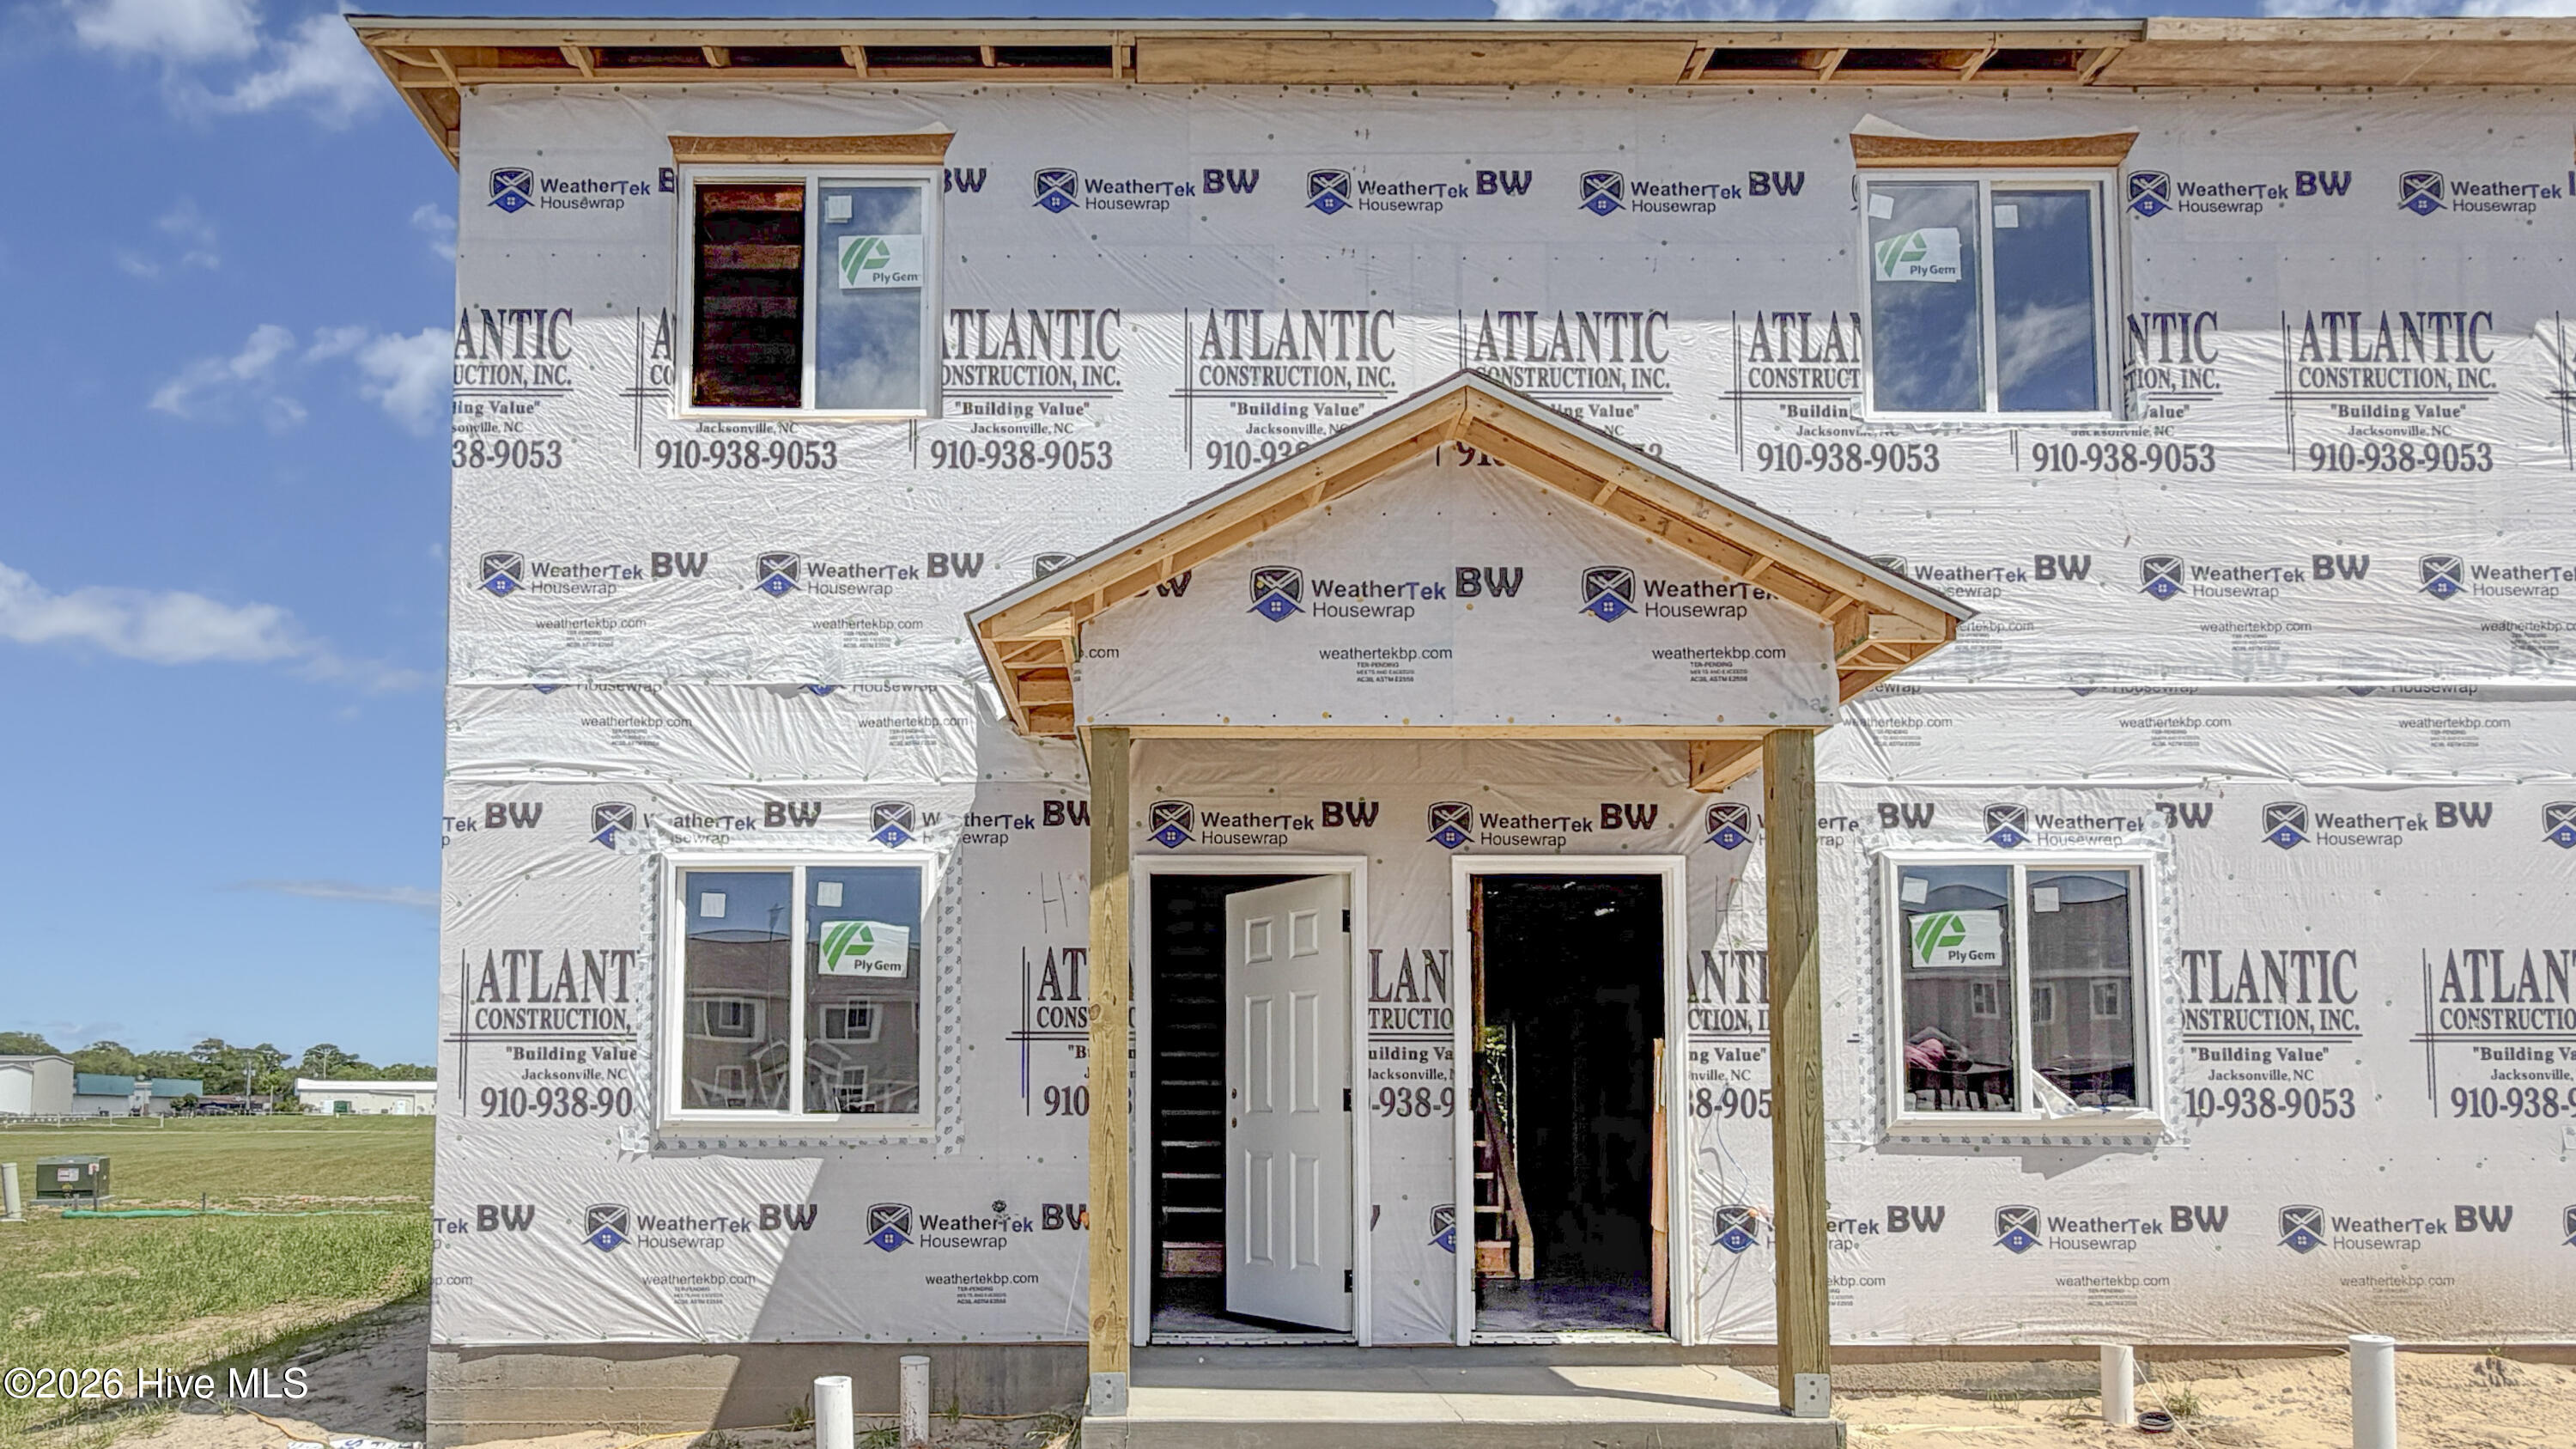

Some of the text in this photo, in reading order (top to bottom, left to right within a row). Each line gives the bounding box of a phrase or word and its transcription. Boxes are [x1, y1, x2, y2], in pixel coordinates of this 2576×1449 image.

[540, 178, 651, 198] WeatherTek
[1084, 169, 1259, 198] WeatherTek BW
[1358, 171, 1532, 199] WeatherTek BW
[1631, 172, 1804, 200] WeatherTek BW
[2178, 172, 2352, 200] WeatherTek BW
[2451, 181, 2562, 200] WeatherTek
[540, 196, 624, 212] Housewrap
[1084, 196, 1170, 212] Housewrap
[1358, 198, 1443, 215] Housewrap
[1631, 199, 1716, 216] Housewrap
[2178, 200, 2263, 216] Housewrap
[2453, 200, 2537, 216] Housewrap
[872, 271, 919, 283] Ply Gem
[1911, 265, 1956, 277] Ply Gem
[1200, 308, 1394, 361] ATLANTIC
[1473, 310, 1670, 363] ATLANTIC
[2299, 311, 2493, 362] ATLANTIC
[534, 365, 572, 386] INC.
[1082, 366, 1121, 387] INC.
[1199, 366, 1394, 390] CONSTRUCTION, INC.
[1632, 368, 1670, 388] INC.
[2181, 368, 2220, 388] INC.
[2299, 367, 2497, 391] CONSTRUCTION, INC.
[489, 400, 540, 415] Value"
[955, 401, 1090, 418] "Building Value"
[1230, 401, 1365, 418] "Building Value"
[1589, 404, 1639, 419] Value"
[2145, 404, 2190, 418] alue"
[2331, 405, 2466, 421] "Building Value"
[504, 422, 524, 433] NC
[970, 422, 1074, 435] Jacksonville, NC
[1245, 423, 1326, 437] Jacksonville,
[2348, 425, 2451, 437] Jacksonville, NC
[655, 439, 838, 470] 910-938-9053
[931, 439, 1114, 470] 910-938-9053
[1757, 441, 1940, 472] 910-938-9053
[2032, 441, 2216, 472] 910-938-9053
[2309, 443, 2493, 472] 910-938-9053
[532, 552, 708, 581] WeatherTek BW
[808, 553, 983, 581] WeatherTek BW
[1915, 554, 2091, 583] WeatherTek BW
[2191, 555, 2369, 584] WeatherTek BW
[2471, 565, 2576, 581] WeatherTe
[532, 580, 617, 596] Housewrap
[808, 581, 893, 597] Housewrap
[1312, 568, 1523, 601] WeatherTek BW
[2193, 583, 2279, 600] Housewrap
[2473, 584, 2559, 599] Housewrap
[1313, 602, 1414, 619] Housewrap
[1645, 602, 1747, 620] Housewrap
[536, 618, 647, 631] weathertekbp.com
[812, 618, 923, 632] weathertekbp.com
[2200, 621, 2312, 634] weathertekbp.com
[1320, 648, 1452, 661] weathertekbp.com
[1652, 647, 1786, 661] weathertekbp.com
[581, 716, 692, 729] weathertekbp.com
[858, 716, 969, 729] weathertekbp.com
[1843, 716, 1953, 729] weathertekbp.com
[2119, 716, 2232, 729] weathertekbp.com
[2398, 717, 2511, 729] weathertekbp.com
[485, 802, 543, 828] BW
[763, 802, 822, 828] BW
[1201, 801, 1379, 831] WeatherTek BW
[1480, 804, 1658, 832] WeatherTek BW
[1878, 804, 1935, 829] BW
[2315, 802, 2492, 831] WeatherTek BW
[1202, 830, 1288, 847] Housewrap
[1481, 832, 1566, 848] Housewrap
[2038, 833, 2123, 849] Housewrap
[2317, 832, 2403, 848] Housewrap
[1949, 950, 1996, 962] Ply Gem
[854, 959, 902, 972] Ply Gem
[2439, 947, 2576, 1004] ATLAN
[475, 1008, 631, 1032] CONSTRUCTION,
[2320, 1009, 2360, 1031] INC.
[506, 1046, 586, 1063] "Building
[1715, 1047, 1767, 1062] Value"
[2191, 1047, 2329, 1064] "Building Value"
[2473, 1046, 2555, 1064] "Building
[521, 1068, 627, 1081] Jacksonville, NC
[1730, 1069, 1752, 1081] NC
[2208, 1069, 2314, 1083] Jacksonville, NC
[2491, 1068, 2574, 1082] Jacksonville,
[477, 1204, 535, 1231] BW
[638, 1204, 817, 1233] WeatherTek BW
[1887, 1206, 1945, 1232] BW
[2048, 1206, 2228, 1235] WeatherTek BW
[2333, 1206, 2512, 1235] WeatherTek BW
[637, 1234, 725, 1251] Housewrap
[920, 1234, 1007, 1251] Housewrap
[2049, 1235, 2136, 1253] Housewrap
[2334, 1235, 2421, 1253] Housewrap
[642, 1274, 756, 1288] weathertekbp.com
[926, 1273, 1039, 1287] weathertekbp.com
[2056, 1275, 2169, 1288] weathertekbp.com
[2340, 1275, 2455, 1288] weathertekbp.com
